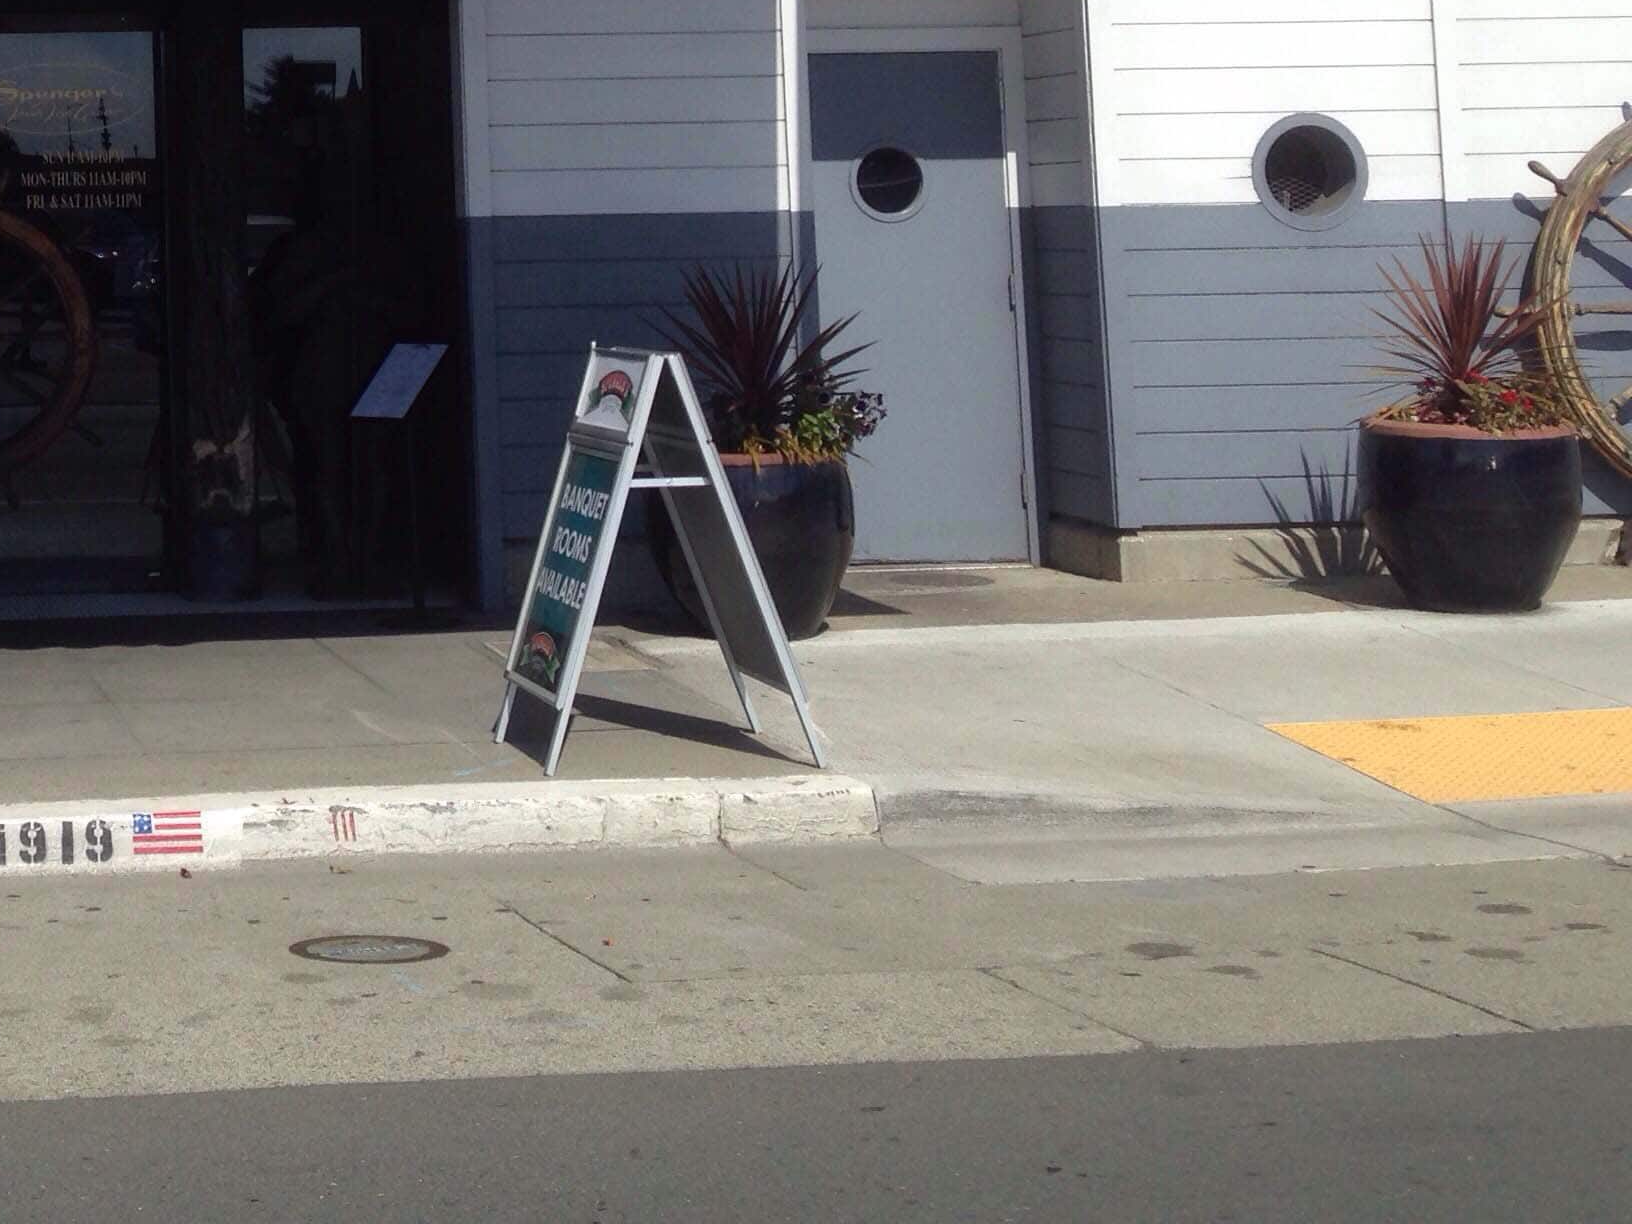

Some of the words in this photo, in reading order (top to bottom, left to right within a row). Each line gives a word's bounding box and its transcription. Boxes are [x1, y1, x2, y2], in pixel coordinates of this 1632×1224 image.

[20, 170, 87, 186] MON-THURS
[88, 170, 147, 186] 11AM-10PM
[560, 483, 609, 520] BANQUET
[552, 526, 593, 564] ROOMS
[536, 566, 587, 610] AVAILABLE
